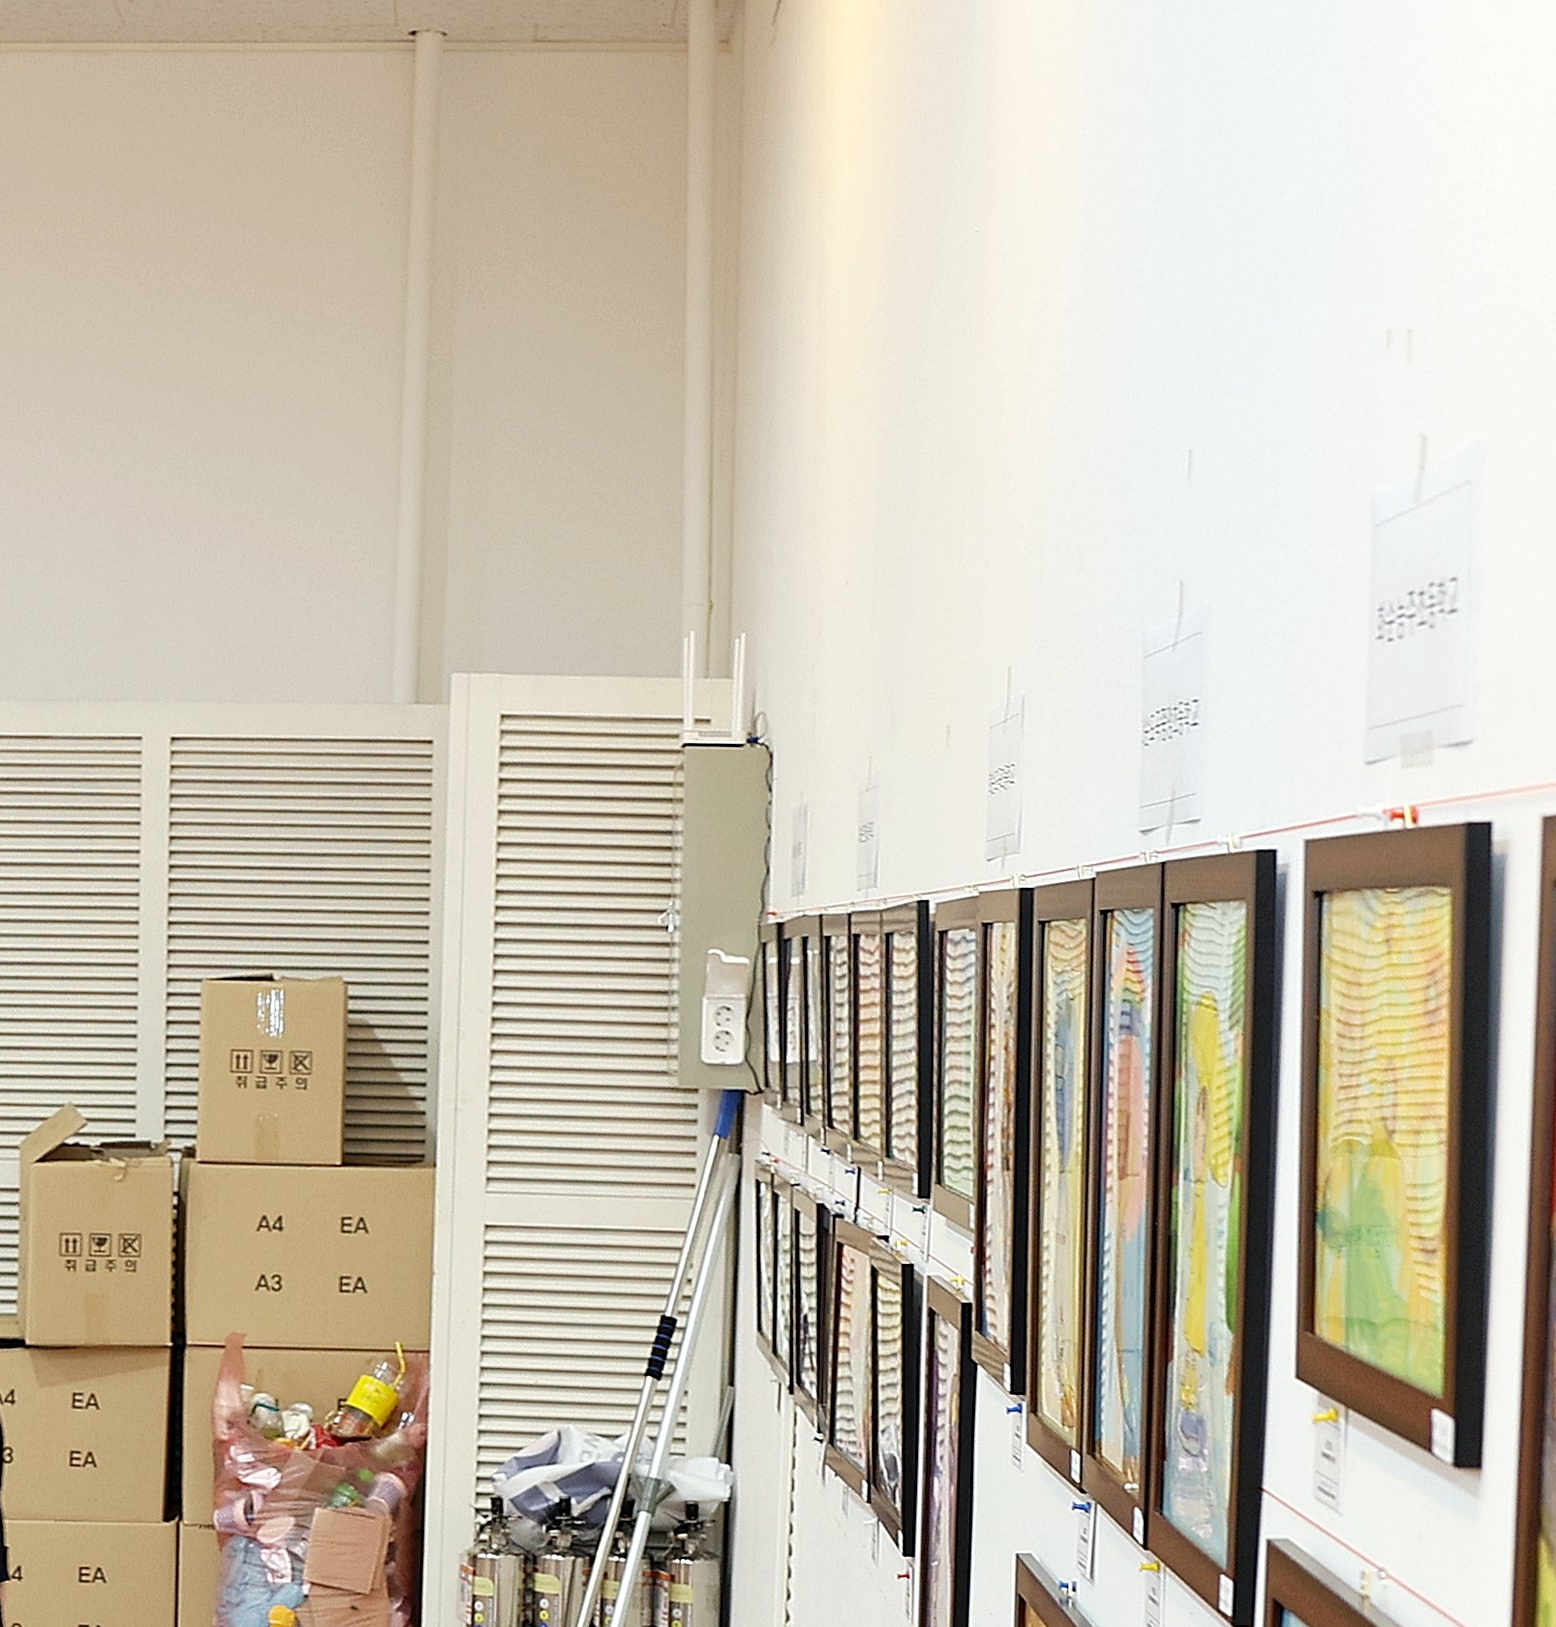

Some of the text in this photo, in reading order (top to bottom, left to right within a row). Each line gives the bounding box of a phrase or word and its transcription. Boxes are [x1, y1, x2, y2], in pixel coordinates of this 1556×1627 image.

[256, 1214, 369, 1234] A4 EA
[254, 1274, 368, 1294] A3 EA
[71, 1392, 100, 1410] EA
[3, 1446, 98, 1468] 3 EA
[11, 1565, 107, 1583] 4 EA
